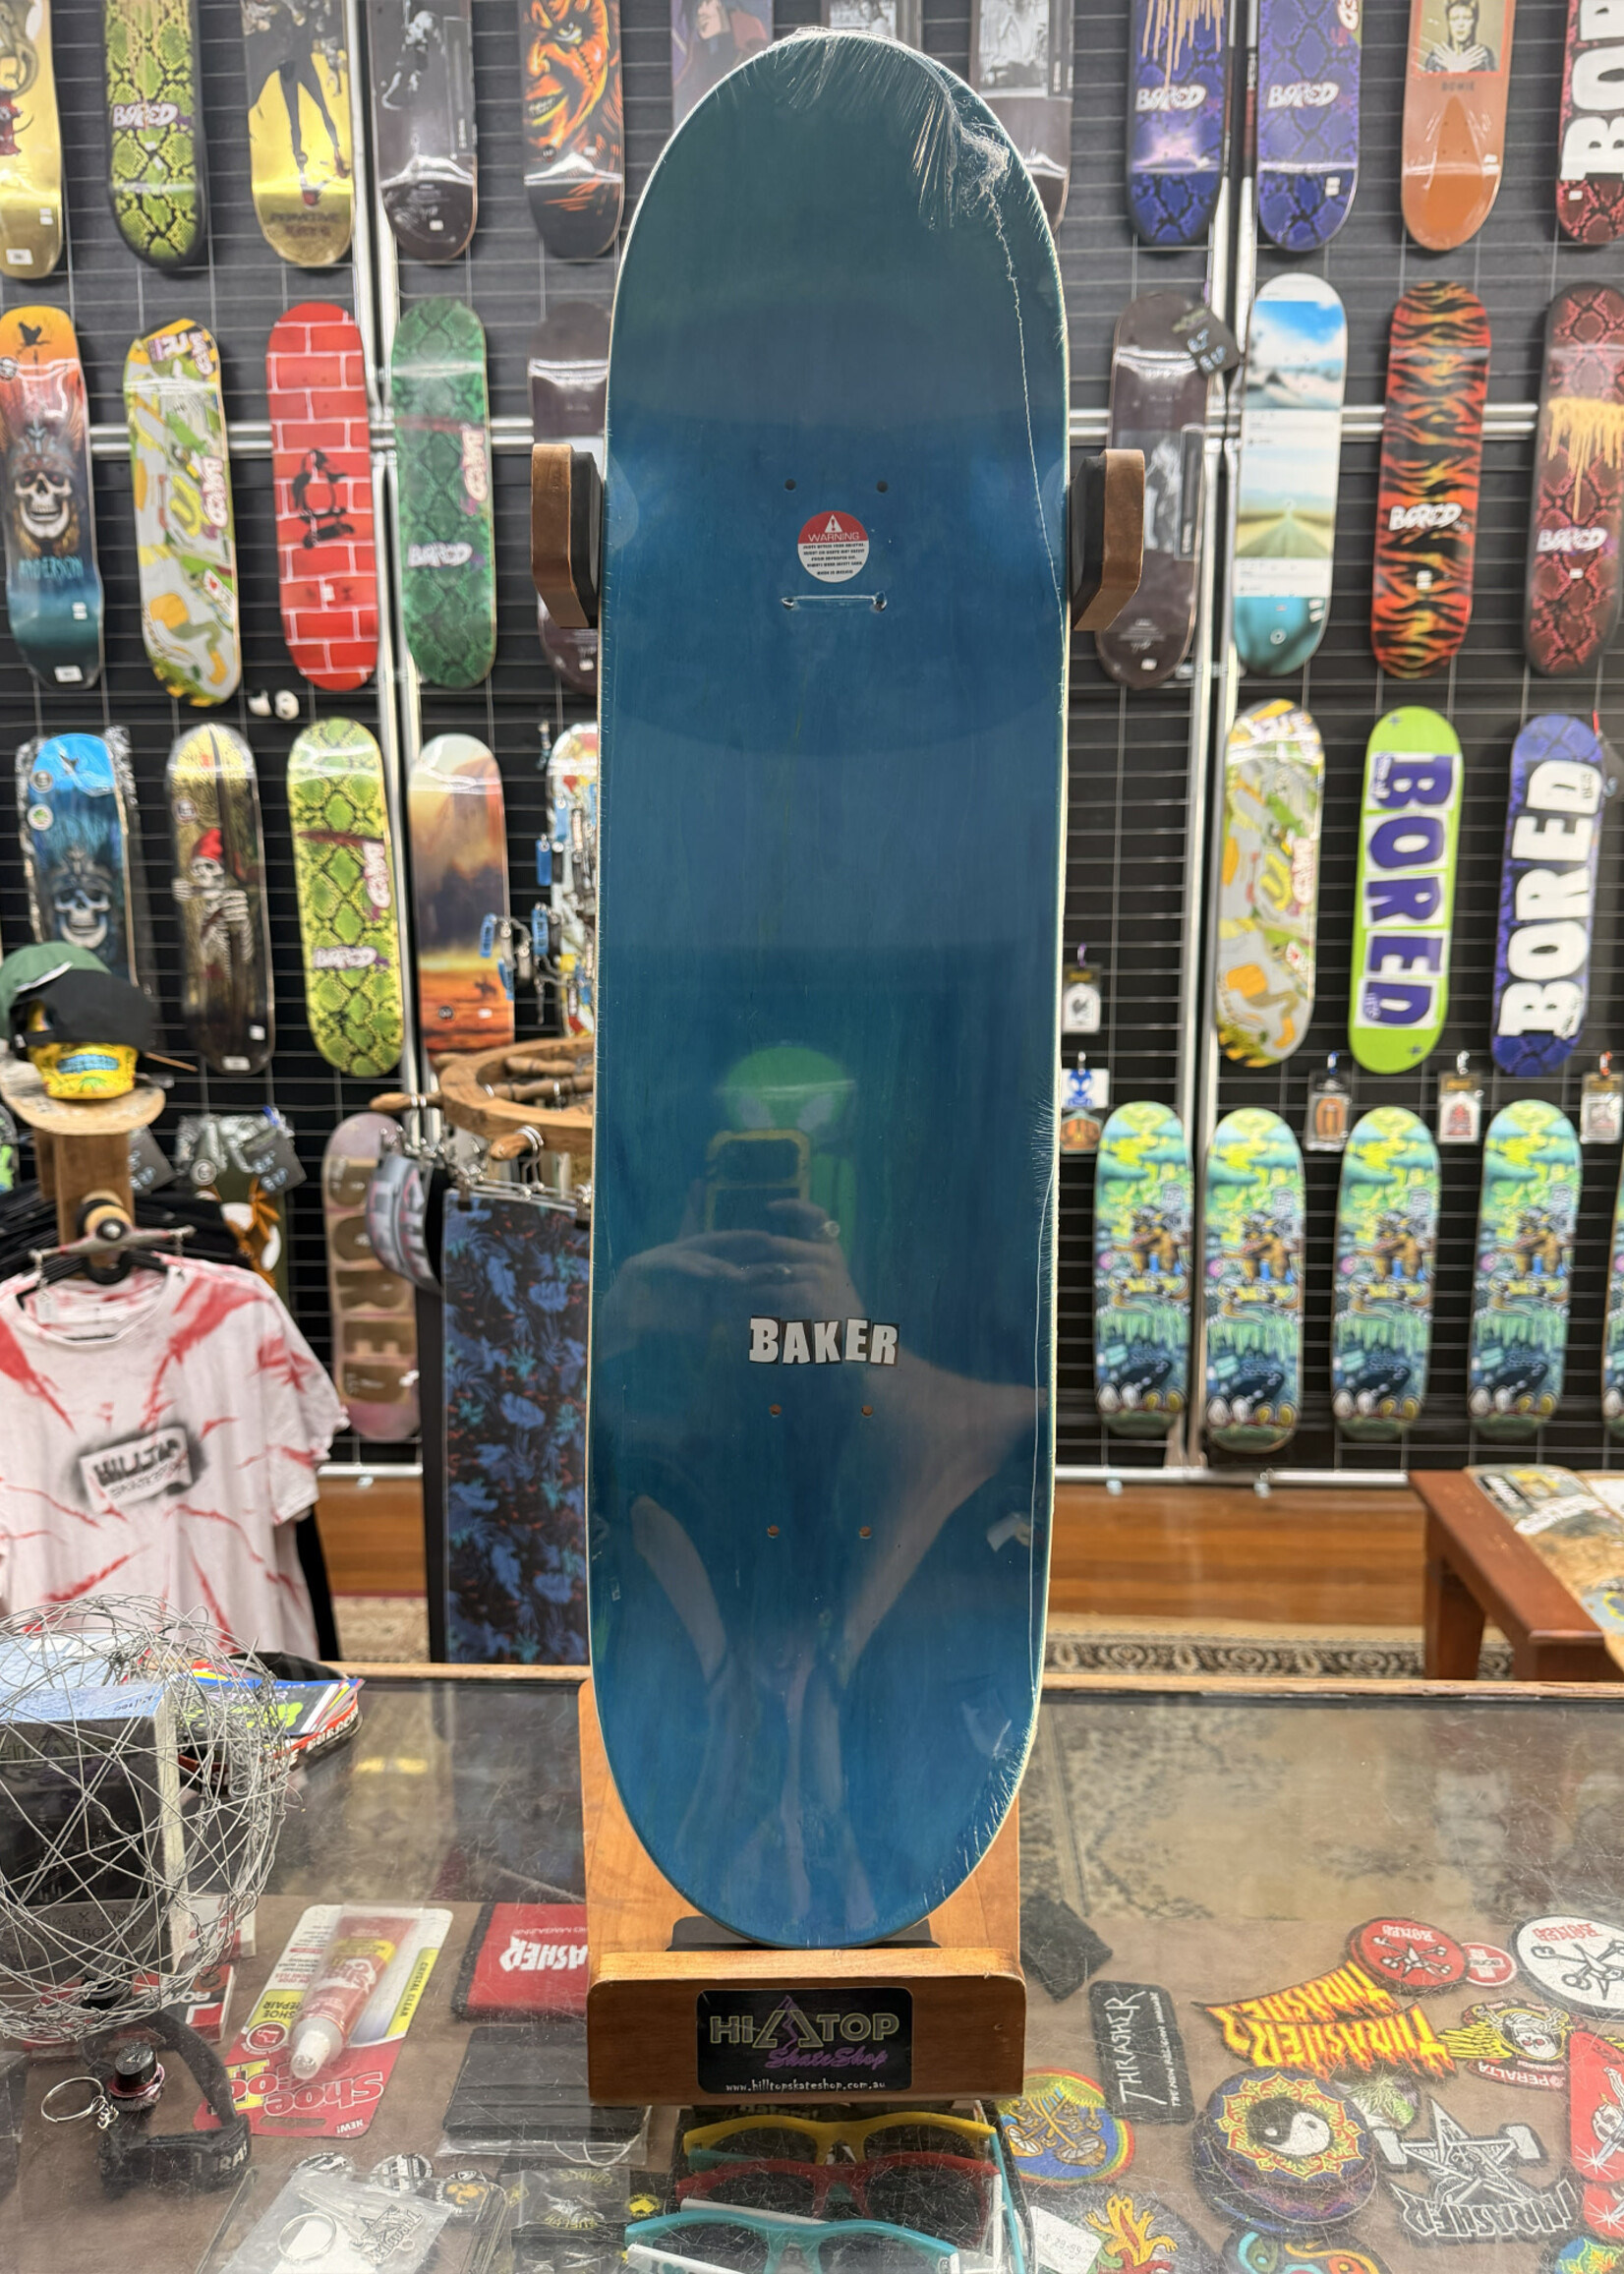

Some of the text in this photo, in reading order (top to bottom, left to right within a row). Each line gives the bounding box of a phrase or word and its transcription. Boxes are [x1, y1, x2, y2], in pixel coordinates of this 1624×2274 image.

[112, 102, 179, 129] BORED
[807, 532, 860, 543] WARNING
[1367, 754, 1454, 1025] BORED
[1497, 759, 1602, 1039] BORED
[748, 1315, 899, 1366] BAKER
[498, 1935, 589, 1972] ASHER
[1102, 1990, 1169, 2107] THRASHER
[1246, 2003, 1458, 2081] THRASHER
[263, 2070, 384, 2117] Shoe
[725, 2076, 887, 2093] www.hilltopskateshop.com.au
[1477, 2062, 1550, 2087] PERALTA
[336, 2118, 364, 2134] NEW!
[1389, 2178, 1581, 2238] THRASHER
